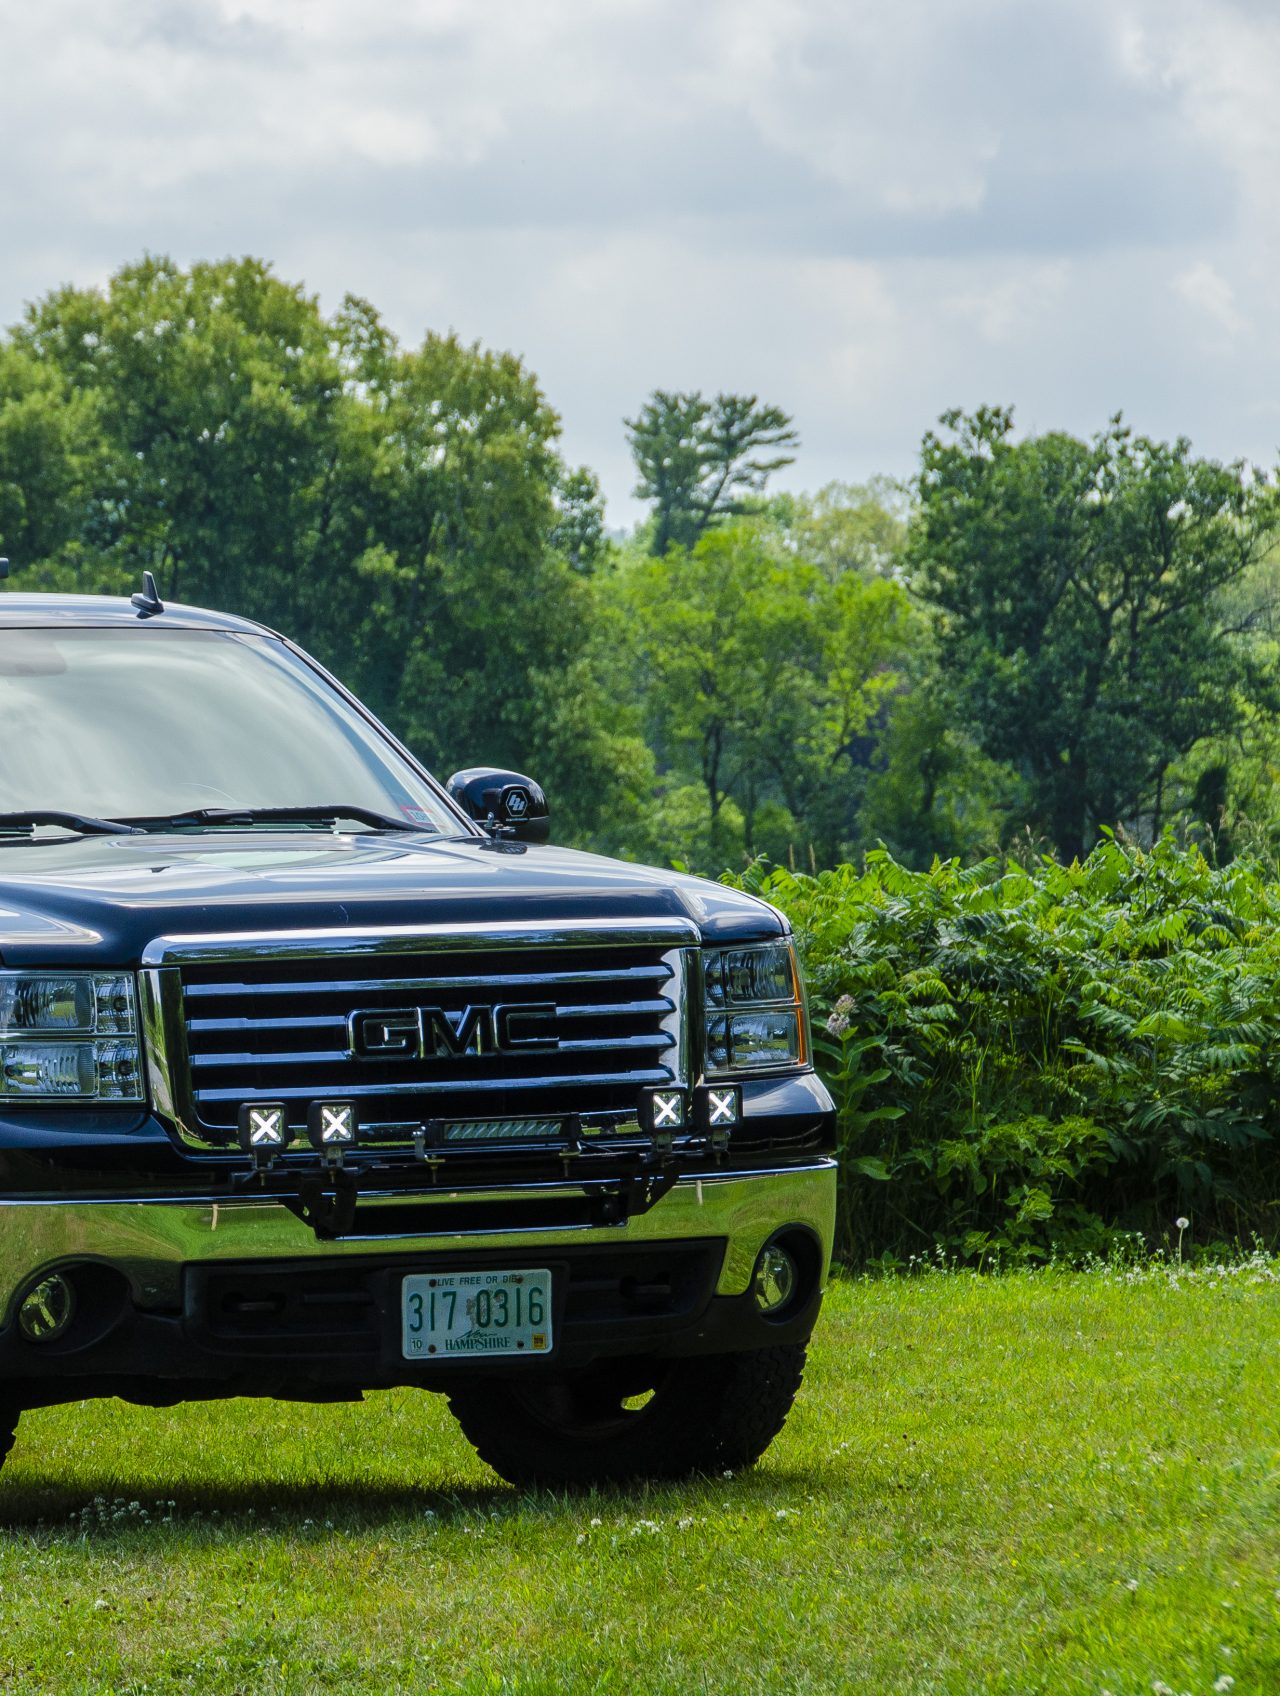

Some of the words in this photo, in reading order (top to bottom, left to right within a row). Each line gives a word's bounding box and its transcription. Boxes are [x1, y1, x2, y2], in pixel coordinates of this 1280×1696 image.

[345, 1002, 560, 1060] GMC
[437, 1277, 455, 1287] LIVE
[459, 1276, 481, 1285] FREE
[485, 1275, 498, 1284] OR
[408, 1290, 457, 1332] 317
[476, 1286, 544, 1328] 0316
[445, 1336, 511, 1351] HAMPSHIRE
